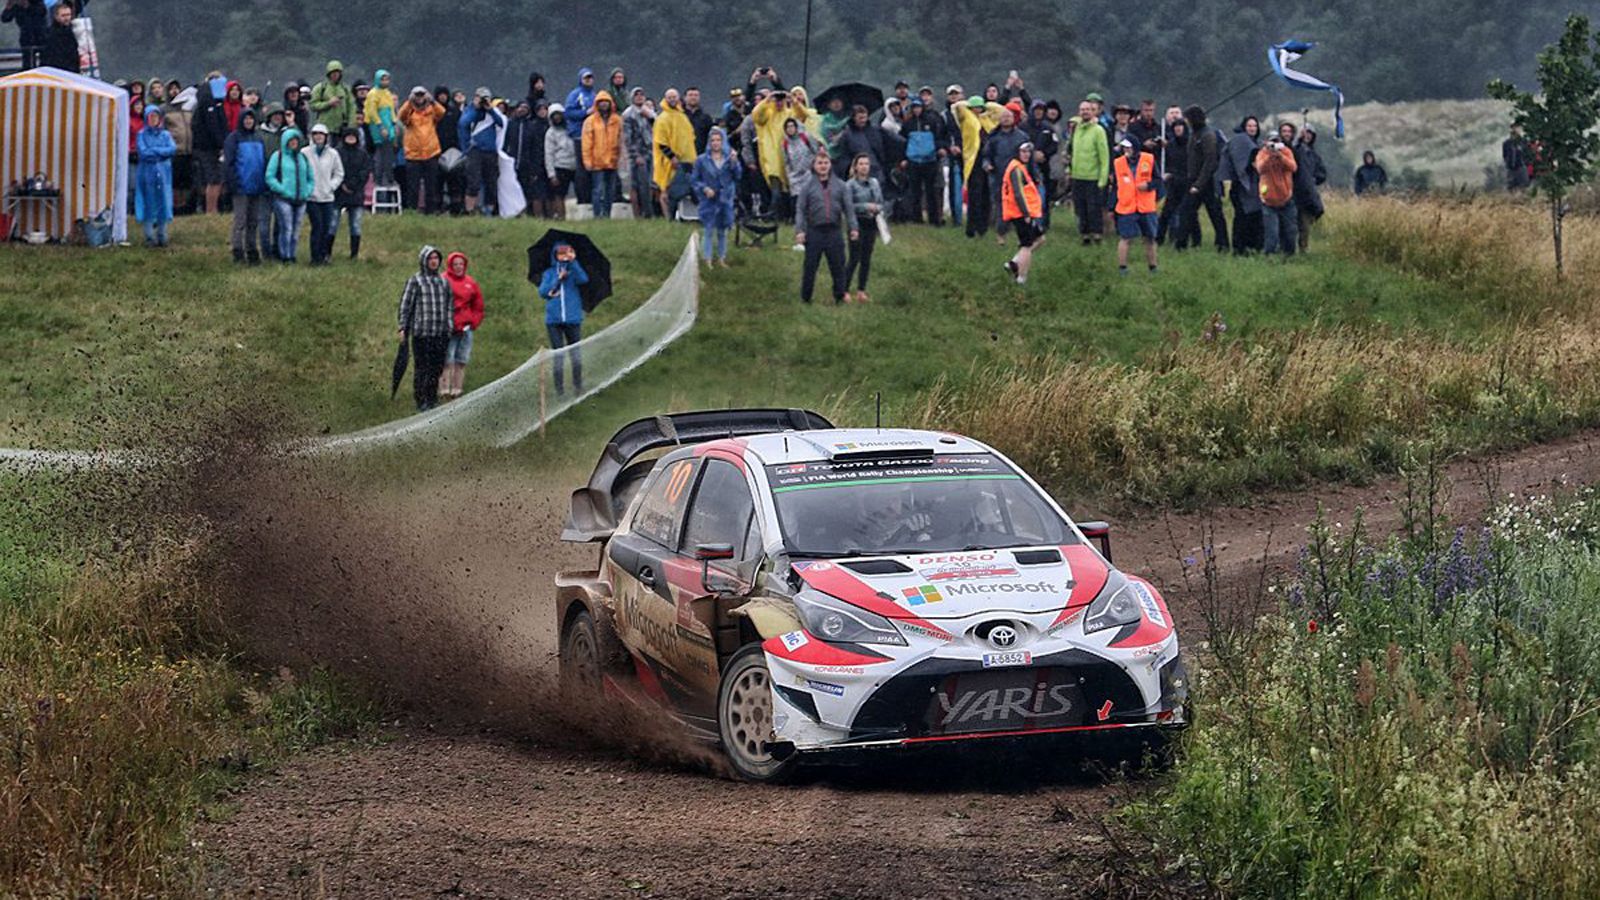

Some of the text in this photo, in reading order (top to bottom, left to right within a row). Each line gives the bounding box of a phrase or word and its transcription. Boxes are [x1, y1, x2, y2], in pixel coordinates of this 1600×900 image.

[810, 461, 874, 471] TOYOTA
[877, 459, 934, 467] GAZOO
[937, 457, 990, 465] Racing
[827, 471, 857, 480] World
[858, 470, 883, 478] Rally
[885, 467, 954, 476] Championship
[664, 460, 693, 505] 10
[919, 554, 995, 565] DENSO
[945, 581, 1059, 597] Microsoft
[877, 635, 900, 643] PIAA
[903, 623, 953, 643] DMG MORI
[814, 665, 865, 675] KONECRANES
